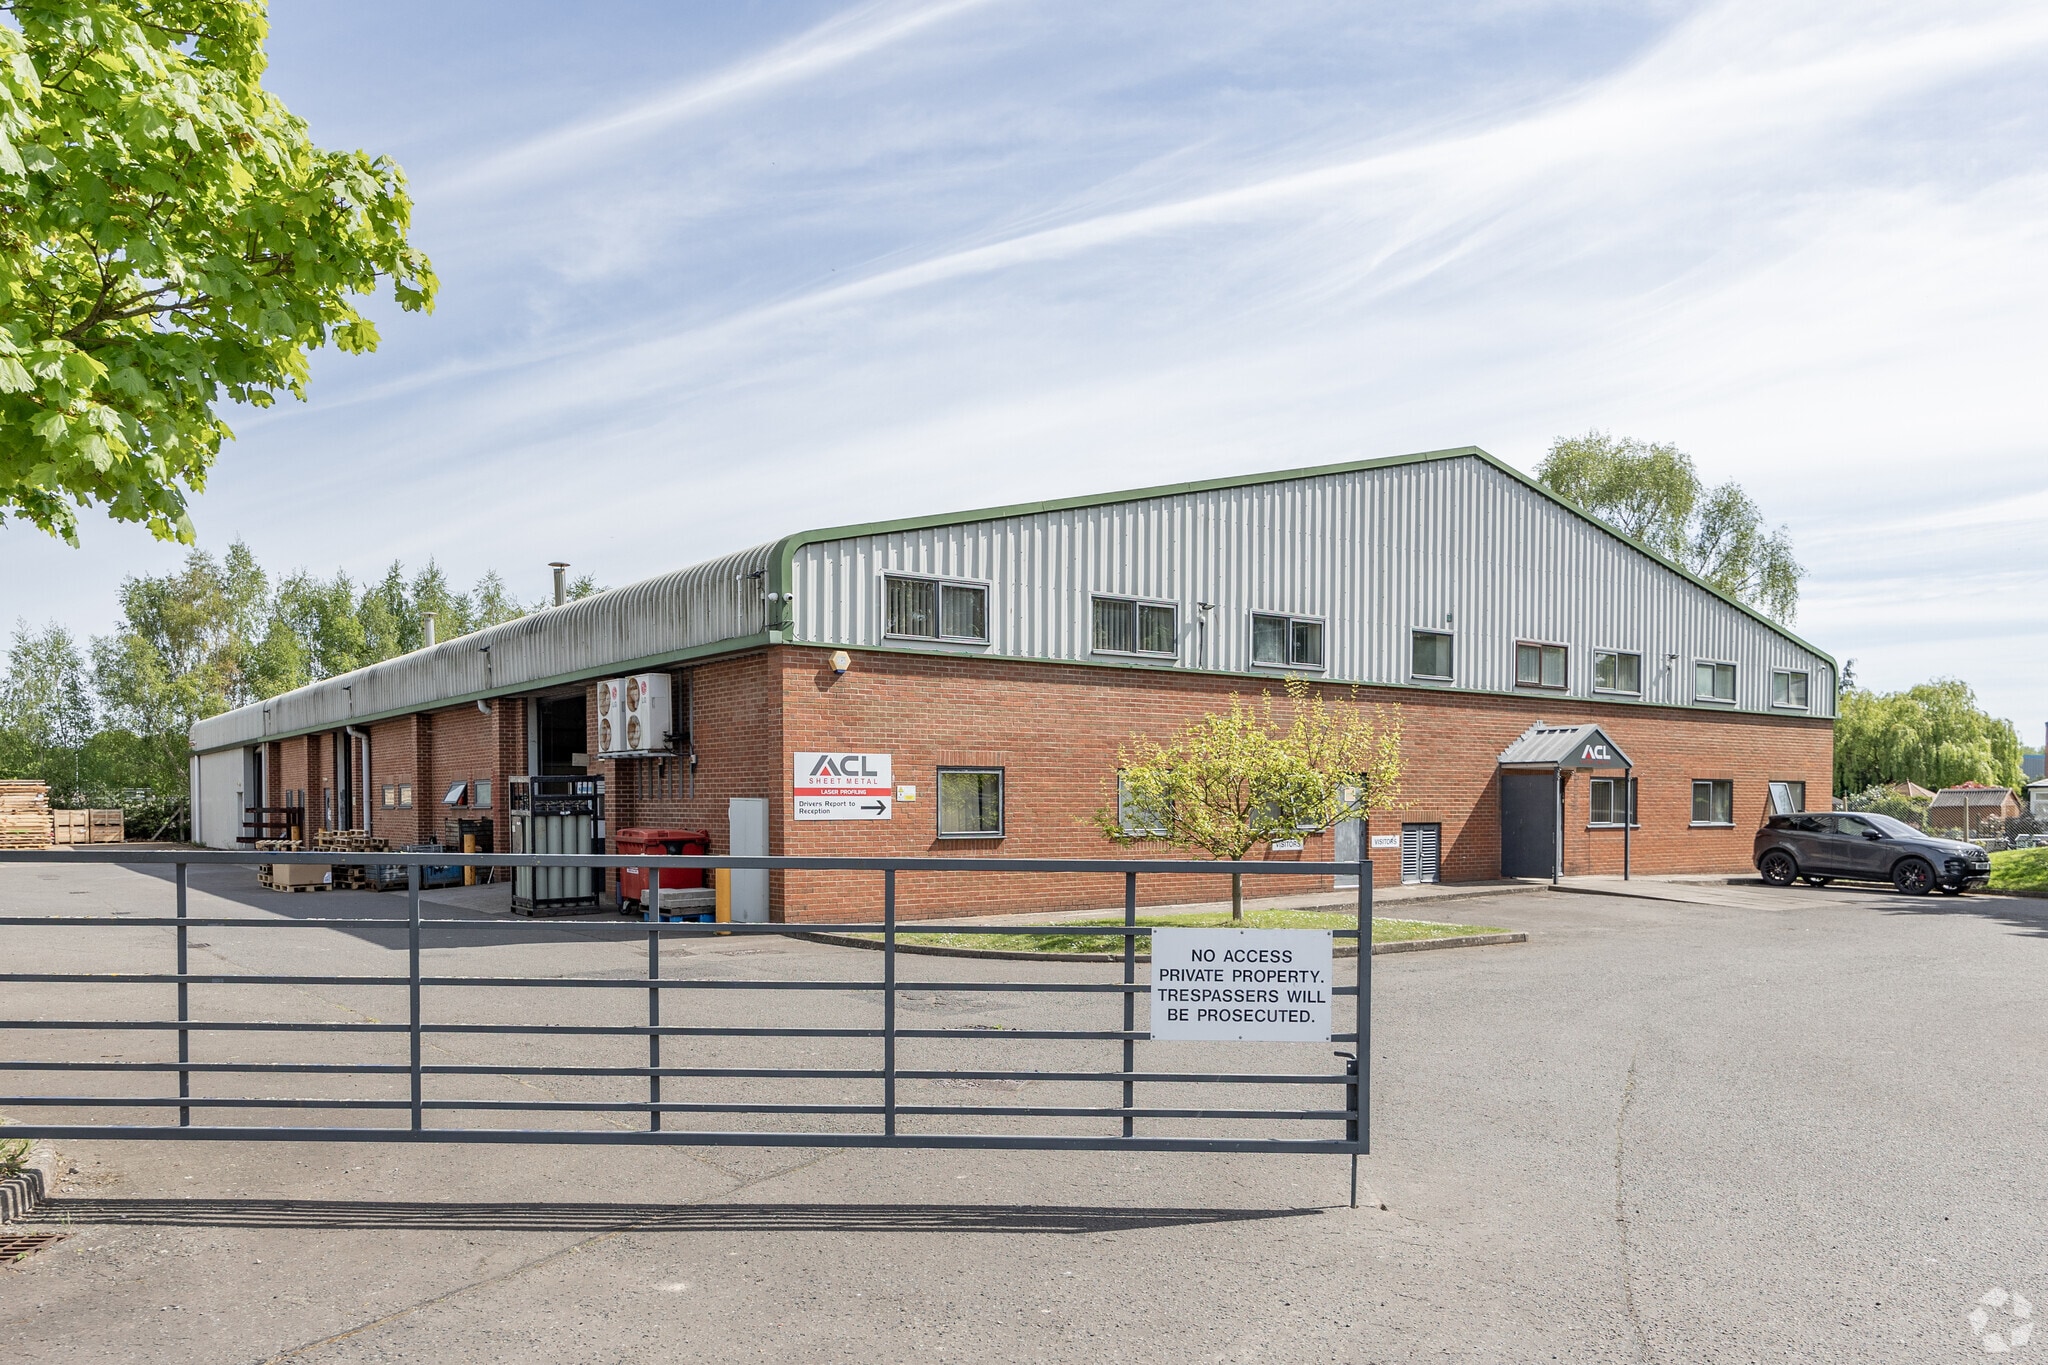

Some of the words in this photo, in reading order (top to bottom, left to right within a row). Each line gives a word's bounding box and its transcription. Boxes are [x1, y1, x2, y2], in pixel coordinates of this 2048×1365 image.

[1581, 744, 1611, 760] ACL
[809, 755, 878, 777] ACL
[808, 777, 842, 785] SHEET
[799, 800, 822, 808] Drivers
[824, 800, 847, 808] Report
[1374, 838, 1398, 846] VISITORS
[1191, 949, 1216, 963] NO
[1223, 949, 1293, 963] ACCESS
[1159, 968, 1224, 982] PRIVATE
[1232, 970, 1325, 984] PROPERTY.
[1157, 988, 1279, 1003] TRESPASSERS
[1287, 990, 1326, 1004] WILL
[1167, 1008, 1189, 1021] BE
[1197, 1008, 1315, 1024] PROSECUTED.
